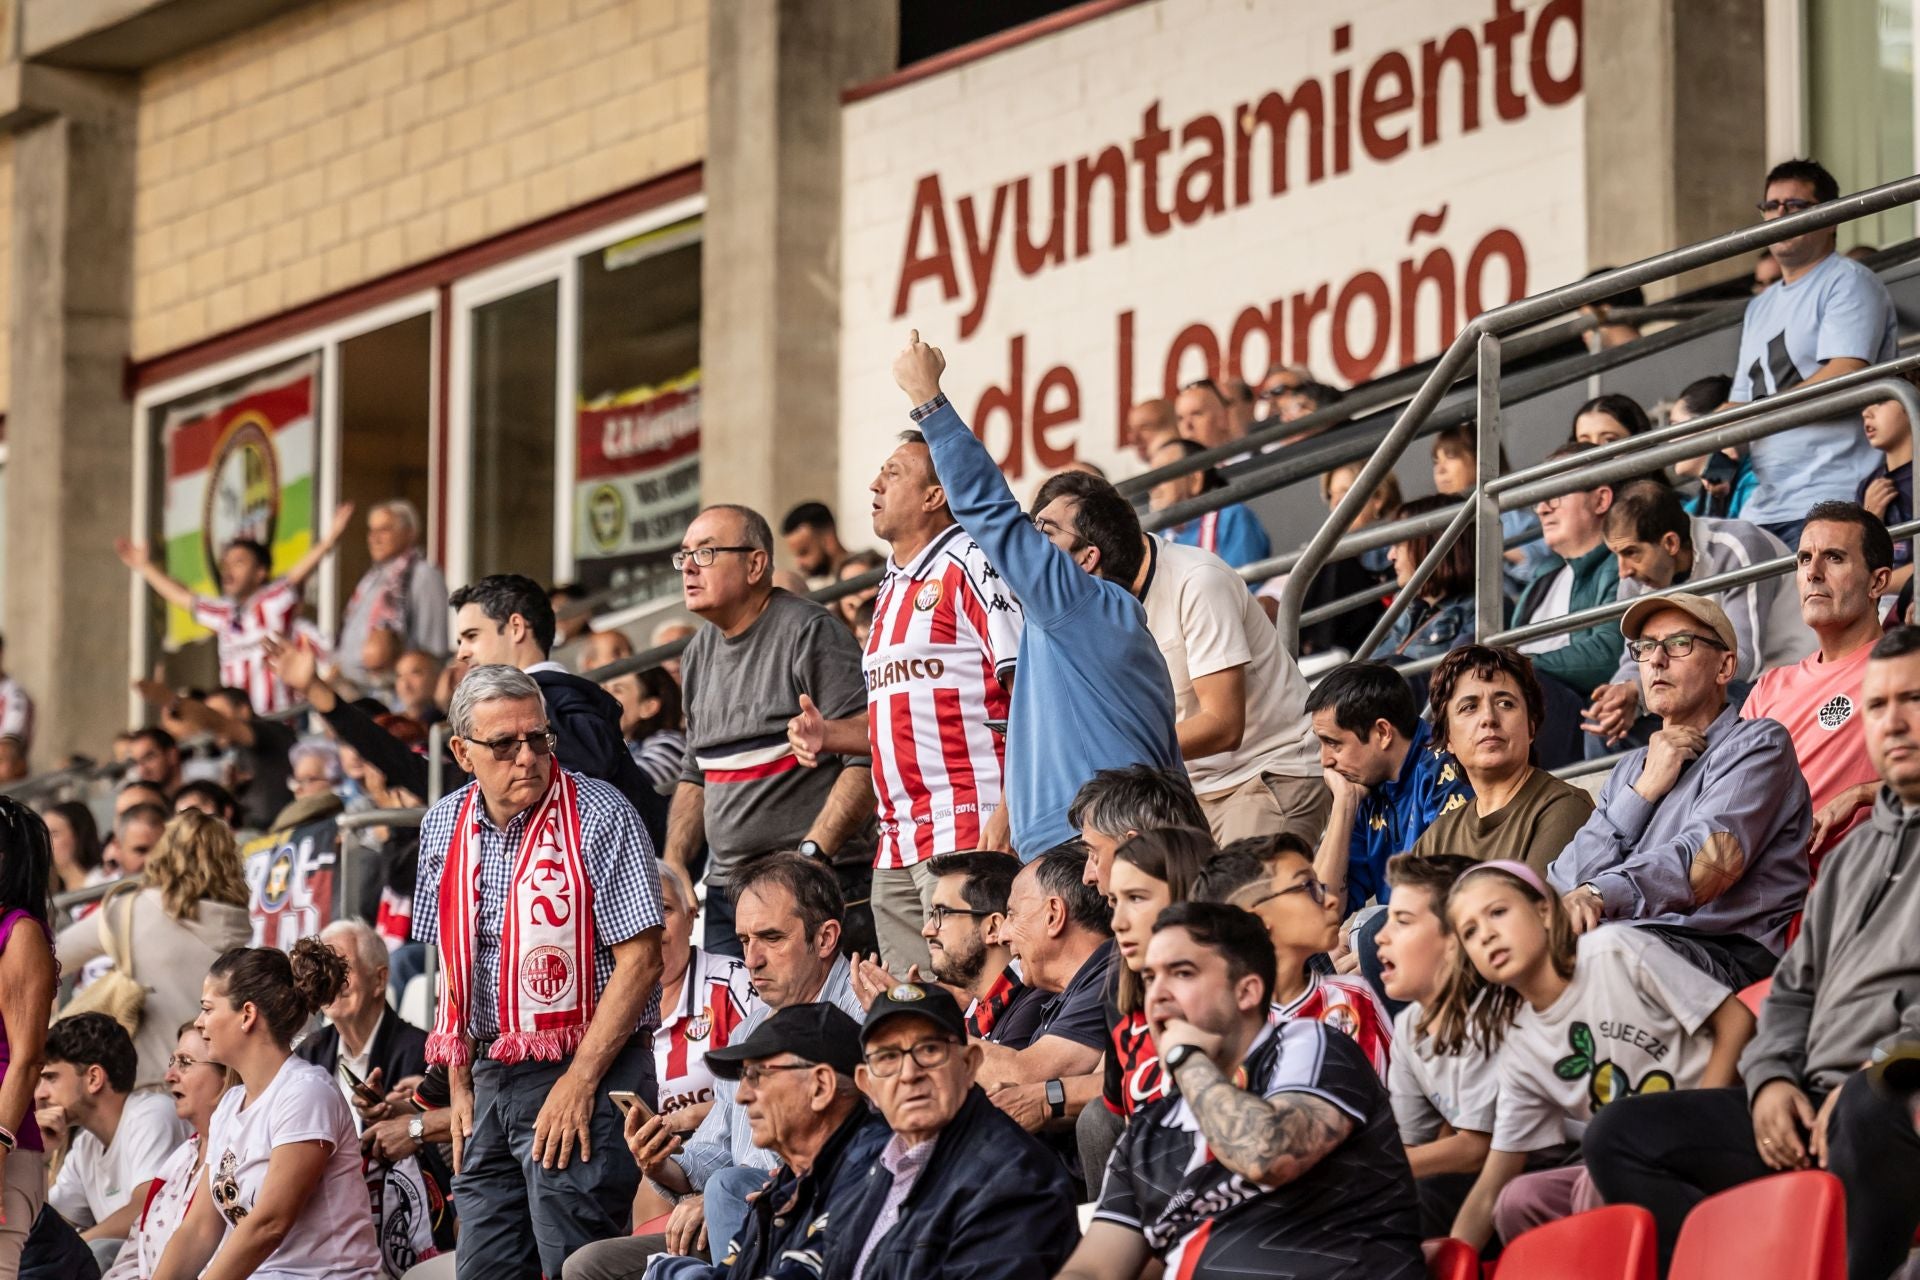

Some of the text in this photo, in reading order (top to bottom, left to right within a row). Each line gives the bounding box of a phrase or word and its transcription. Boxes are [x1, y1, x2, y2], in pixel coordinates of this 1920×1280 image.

[892, 0, 1583, 341] Ayuntamiento
[974, 334, 1080, 479] de
[955, 803, 978, 815] 2014
[980, 802, 999, 813] 201
